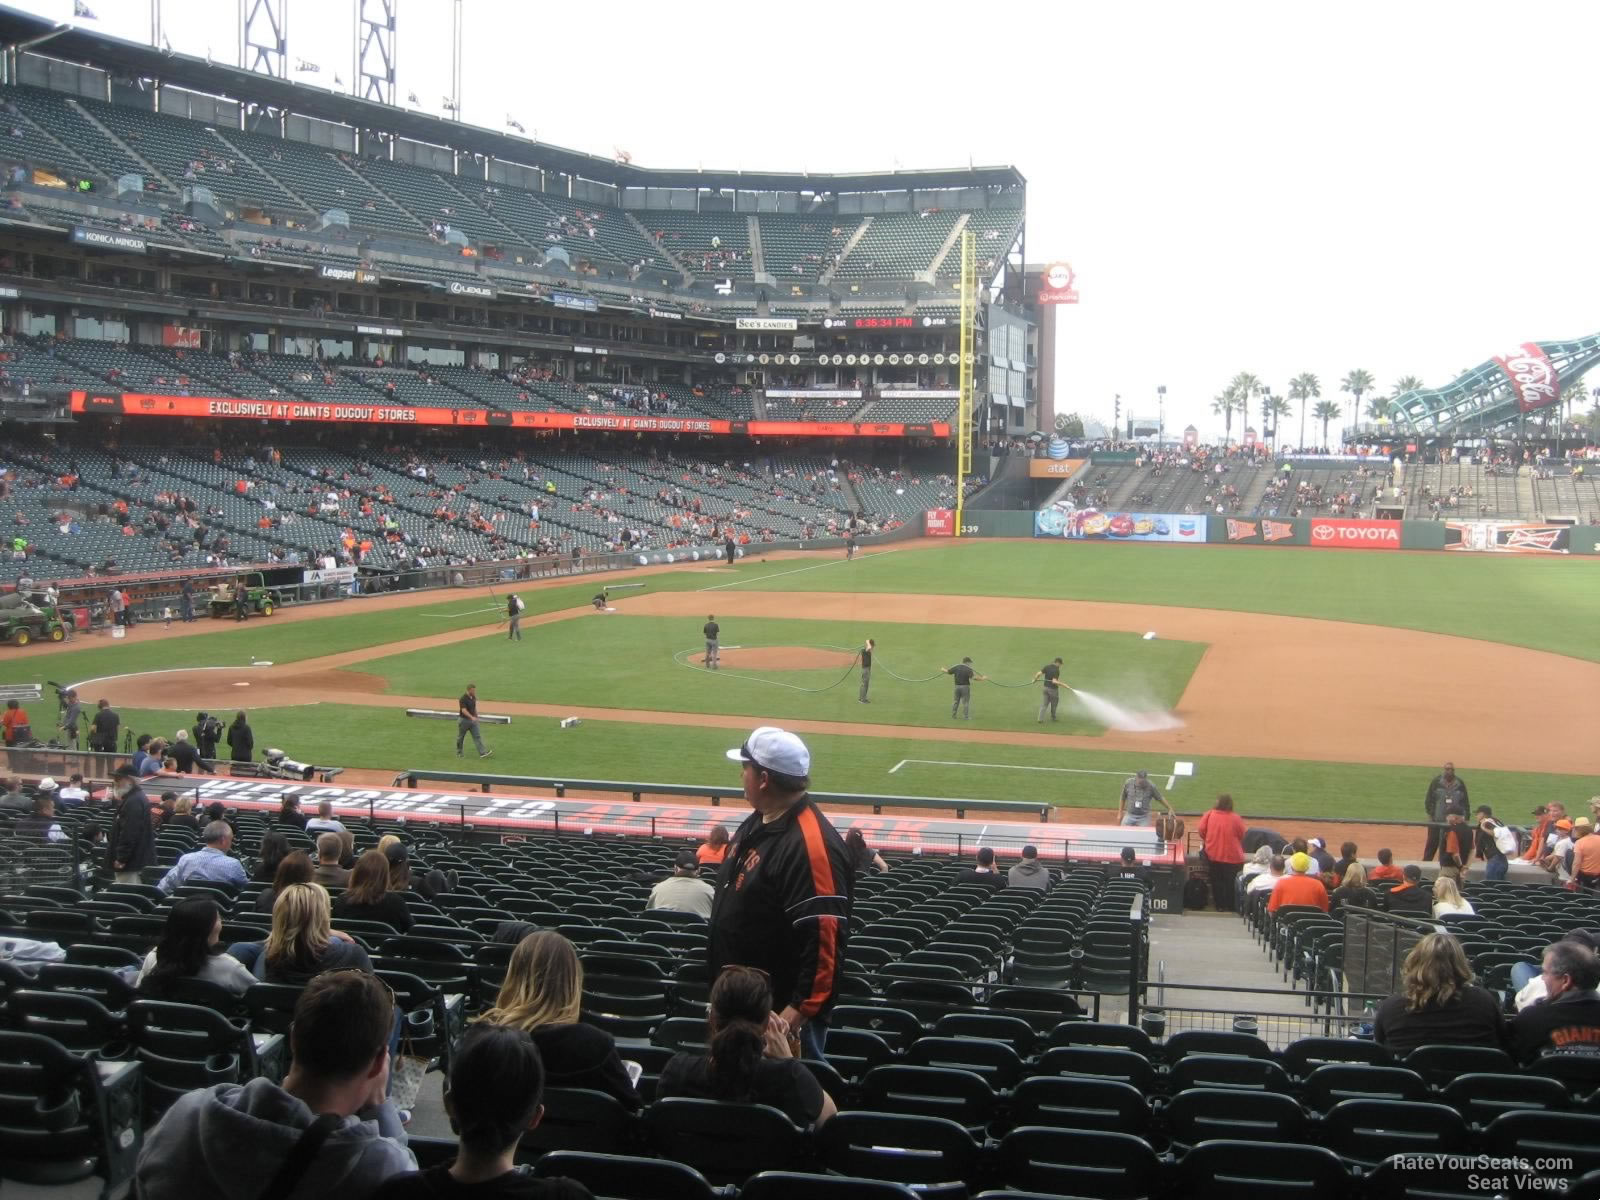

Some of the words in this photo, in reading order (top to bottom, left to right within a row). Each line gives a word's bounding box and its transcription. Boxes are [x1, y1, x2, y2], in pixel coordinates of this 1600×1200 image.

[86, 232, 114, 244] KONICA
[115, 237, 145, 249] MINOLTA
[462, 286, 491, 296] LEXUS
[738, 319, 761, 328] See's
[763, 321, 794, 329] CANDIES
[895, 318, 913, 327] PM
[209, 402, 273, 417] EXCLUSIVELY
[277, 405, 288, 416] AT
[293, 406, 330, 418] GIANTS
[336, 407, 374, 419] DUGOUT
[378, 409, 417, 420] STORES.
[573, 416, 620, 428] EXCLUSIVELY
[623, 419, 631, 428] AT
[634, 419, 657, 429] GIANTS
[660, 420, 684, 430] DUGOUT
[1047, 463, 1071, 473] at&t
[927, 511, 937, 520] FLY
[960, 525, 979, 533] 339
[1337, 527, 1398, 540] TOYOTA
[182, 780, 468, 812] WELCOME
[476, 799, 556, 818] TO
